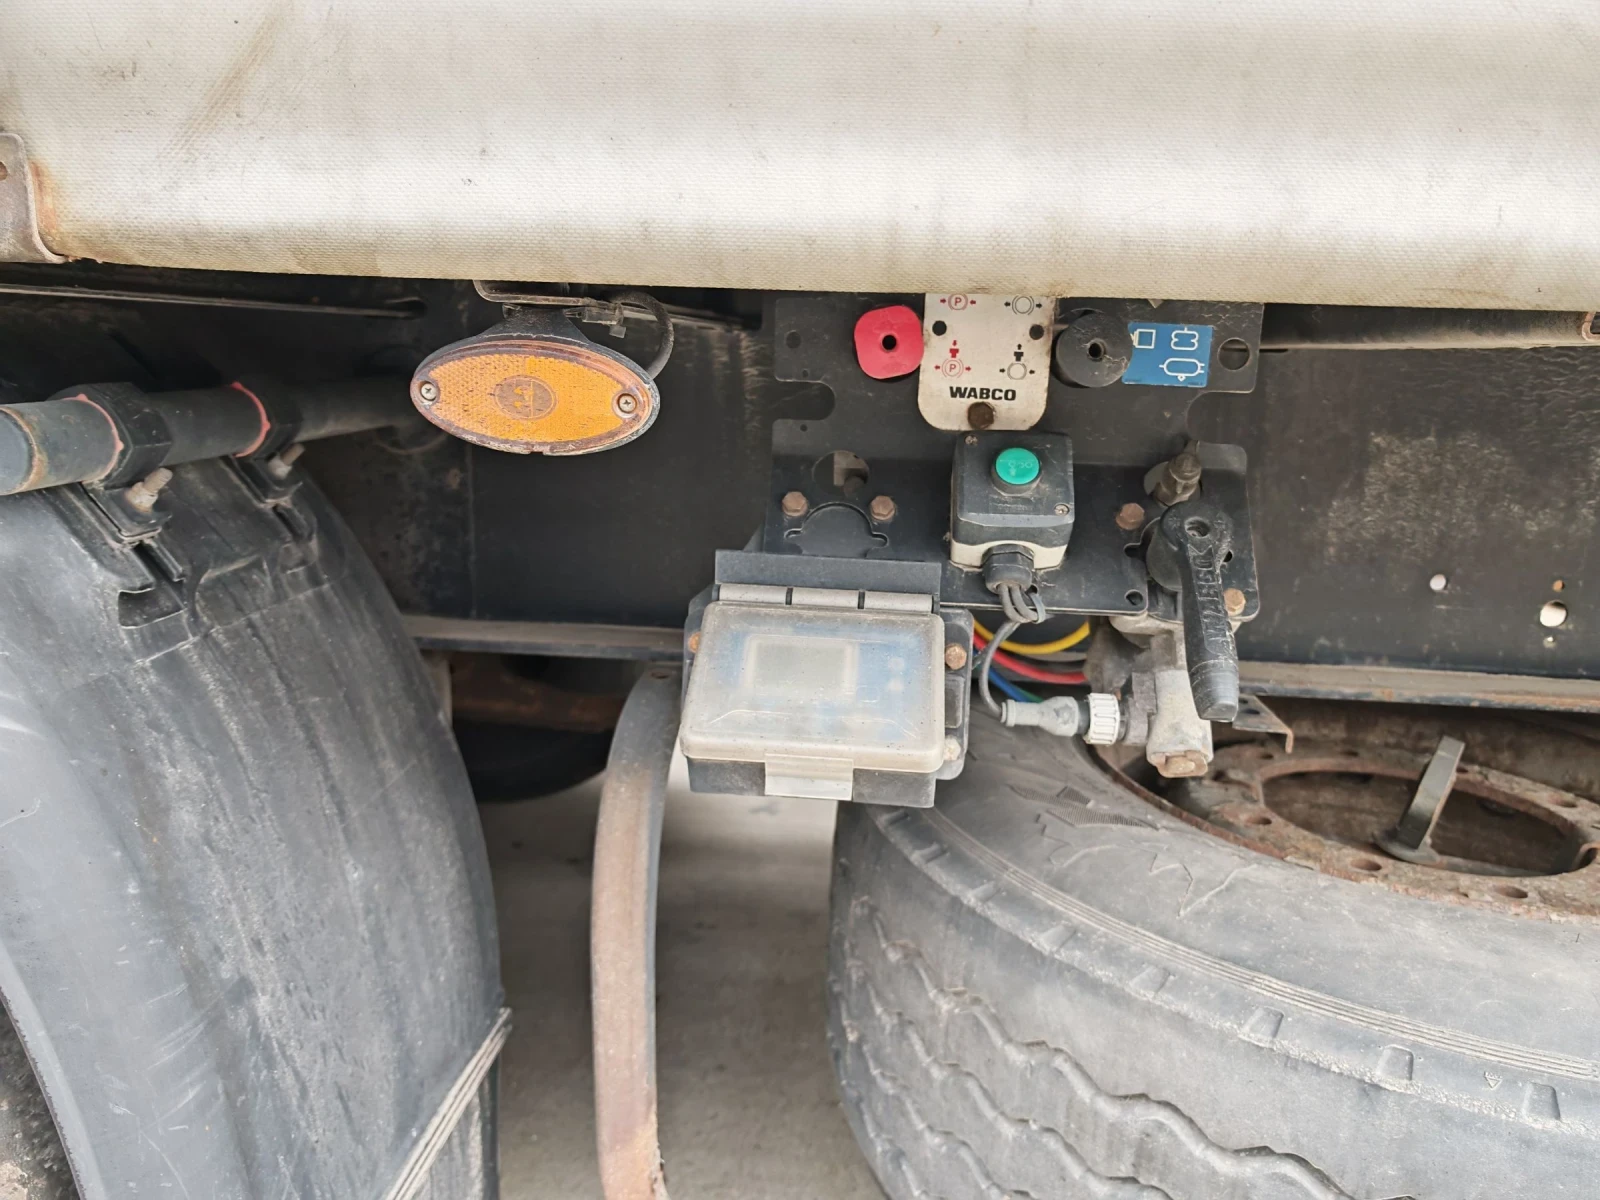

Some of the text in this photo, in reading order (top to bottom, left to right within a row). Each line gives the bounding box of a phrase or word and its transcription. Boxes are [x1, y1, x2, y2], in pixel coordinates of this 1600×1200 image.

[954, 297, 962, 306] P
[949, 364, 956, 373] P
[949, 386, 1017, 401] WABCO
